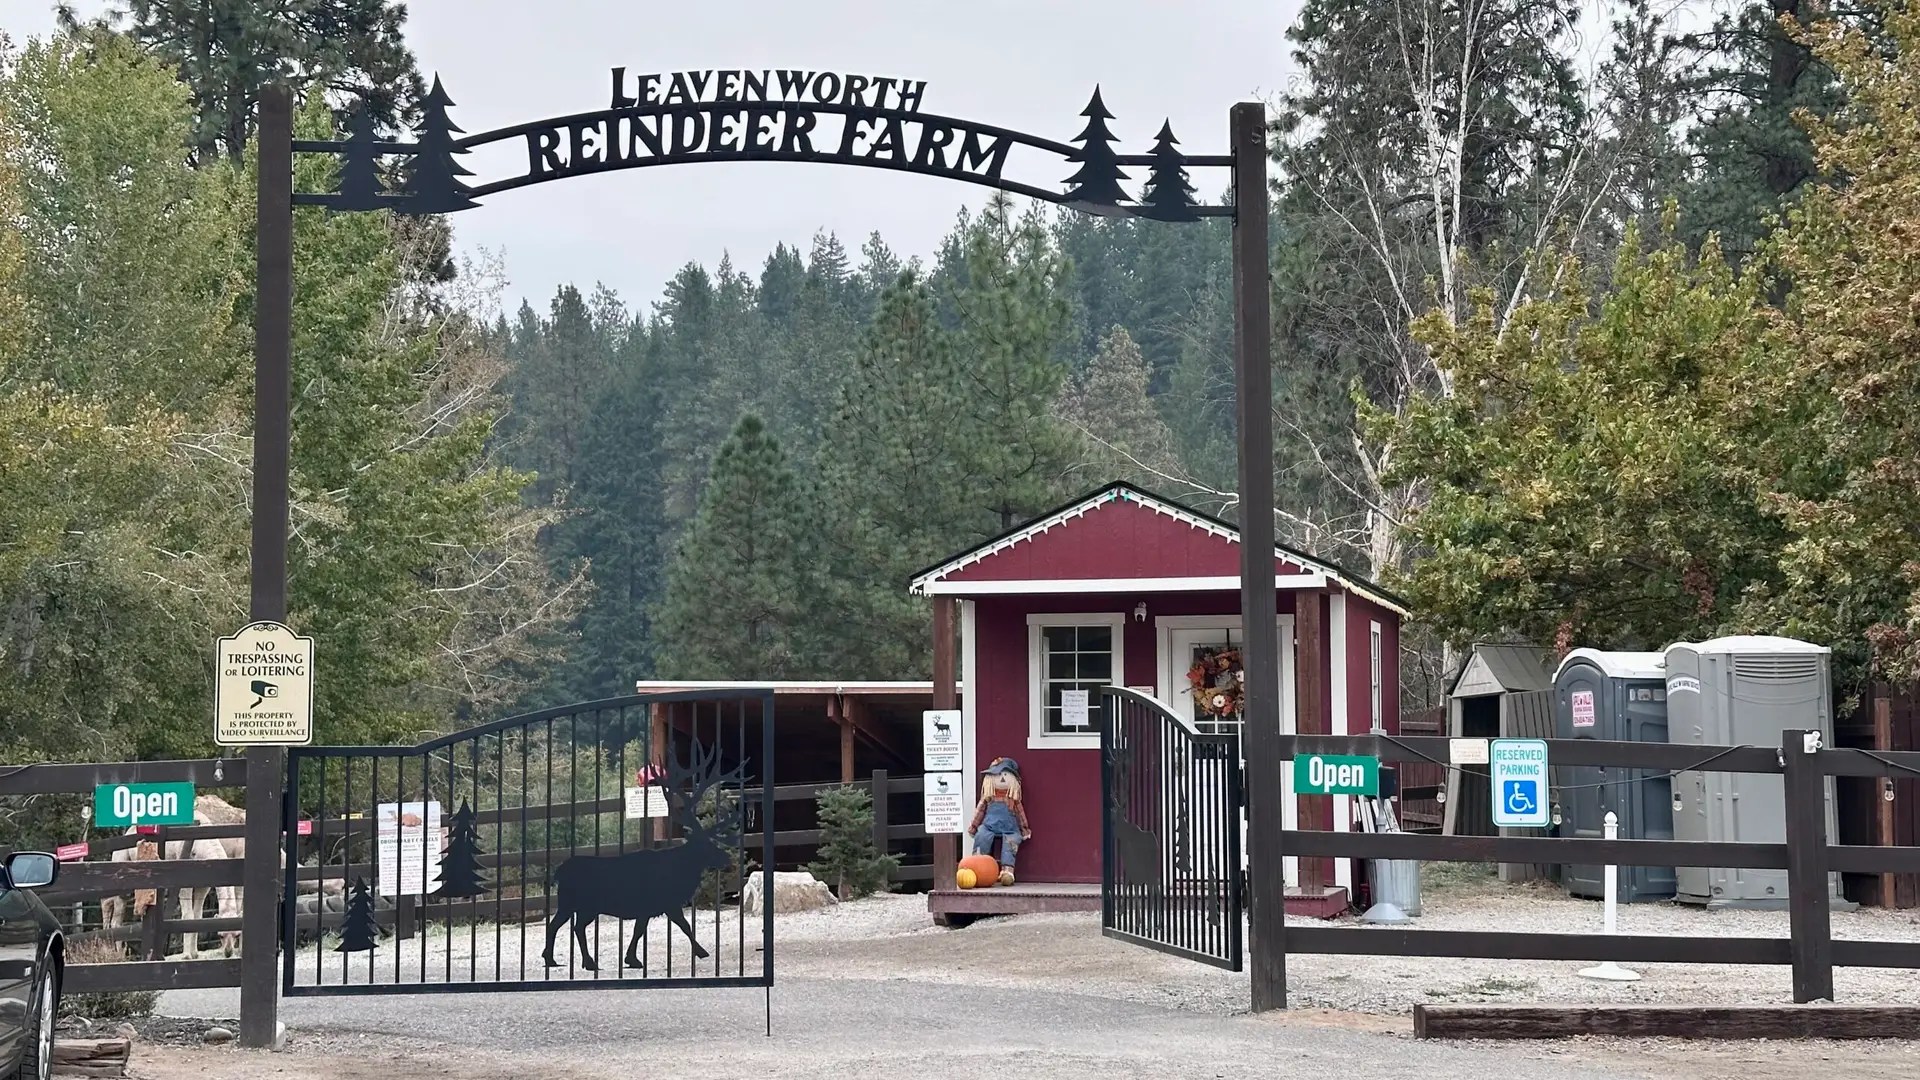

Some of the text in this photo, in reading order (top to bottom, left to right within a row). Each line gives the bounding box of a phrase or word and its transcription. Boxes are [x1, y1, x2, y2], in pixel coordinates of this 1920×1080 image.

[610, 66, 928, 113] LEAVENWORTH
[526, 106, 1014, 179] REINDEER FARM
[255, 641, 275, 652] NO
[227, 653, 303, 664] TRESPASSING
[241, 666, 305, 676] LOITERING
[239, 720, 284, 728] PROTECTED
[1496, 749, 1543, 761] RESERVED
[1309, 756, 1364, 793] Open
[1500, 764, 1540, 776] PARKING
[113, 785, 178, 824] Open
